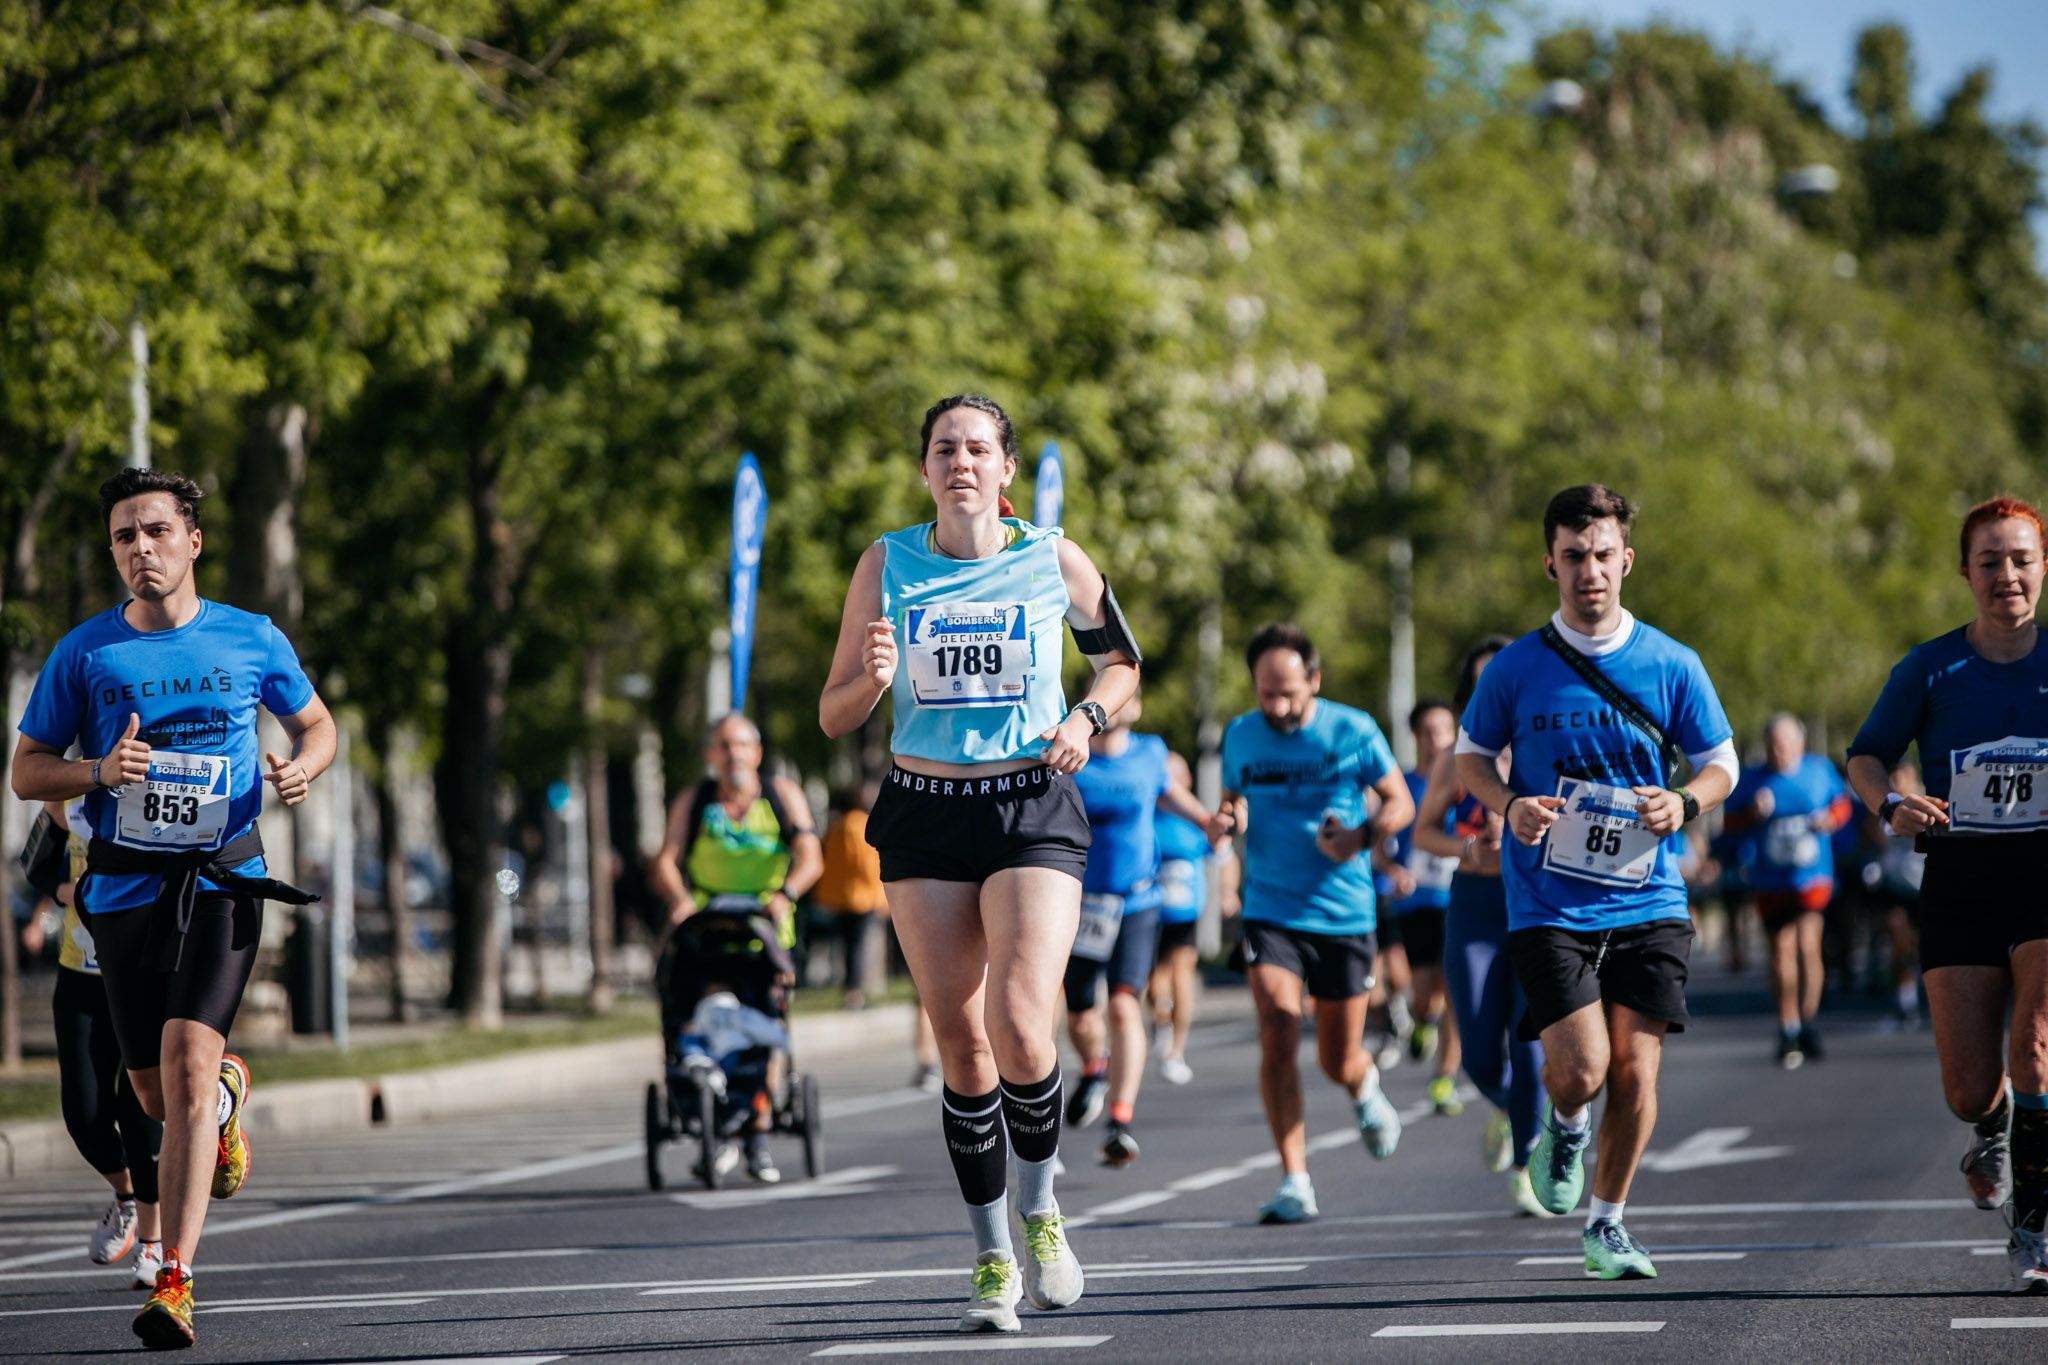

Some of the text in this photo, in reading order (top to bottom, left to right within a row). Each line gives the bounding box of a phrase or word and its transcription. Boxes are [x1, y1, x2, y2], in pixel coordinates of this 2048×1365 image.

[947, 616, 1005, 626] BOMBEROS
[940, 633, 1003, 643] DECIMAS
[933, 644, 1002, 677] 1789
[103, 675, 232, 706] DECIMAS
[146, 721, 225, 733] OMBEROS
[1533, 710, 1620, 732] DECIM
[186, 732, 224, 745] MADRID
[156, 765, 210, 778] BOMBEROS
[147, 782, 207, 795] DECIMAS
[893, 766, 1054, 796] UNDER ARMOUR
[1984, 773, 2034, 804] 478
[143, 792, 199, 826] 853
[1585, 812, 1640, 829] DECIMAS
[1585, 824, 1623, 857] 85
[1010, 1118, 1055, 1134] SPORTLAST
[950, 1134, 997, 1154] SPORTLAST
